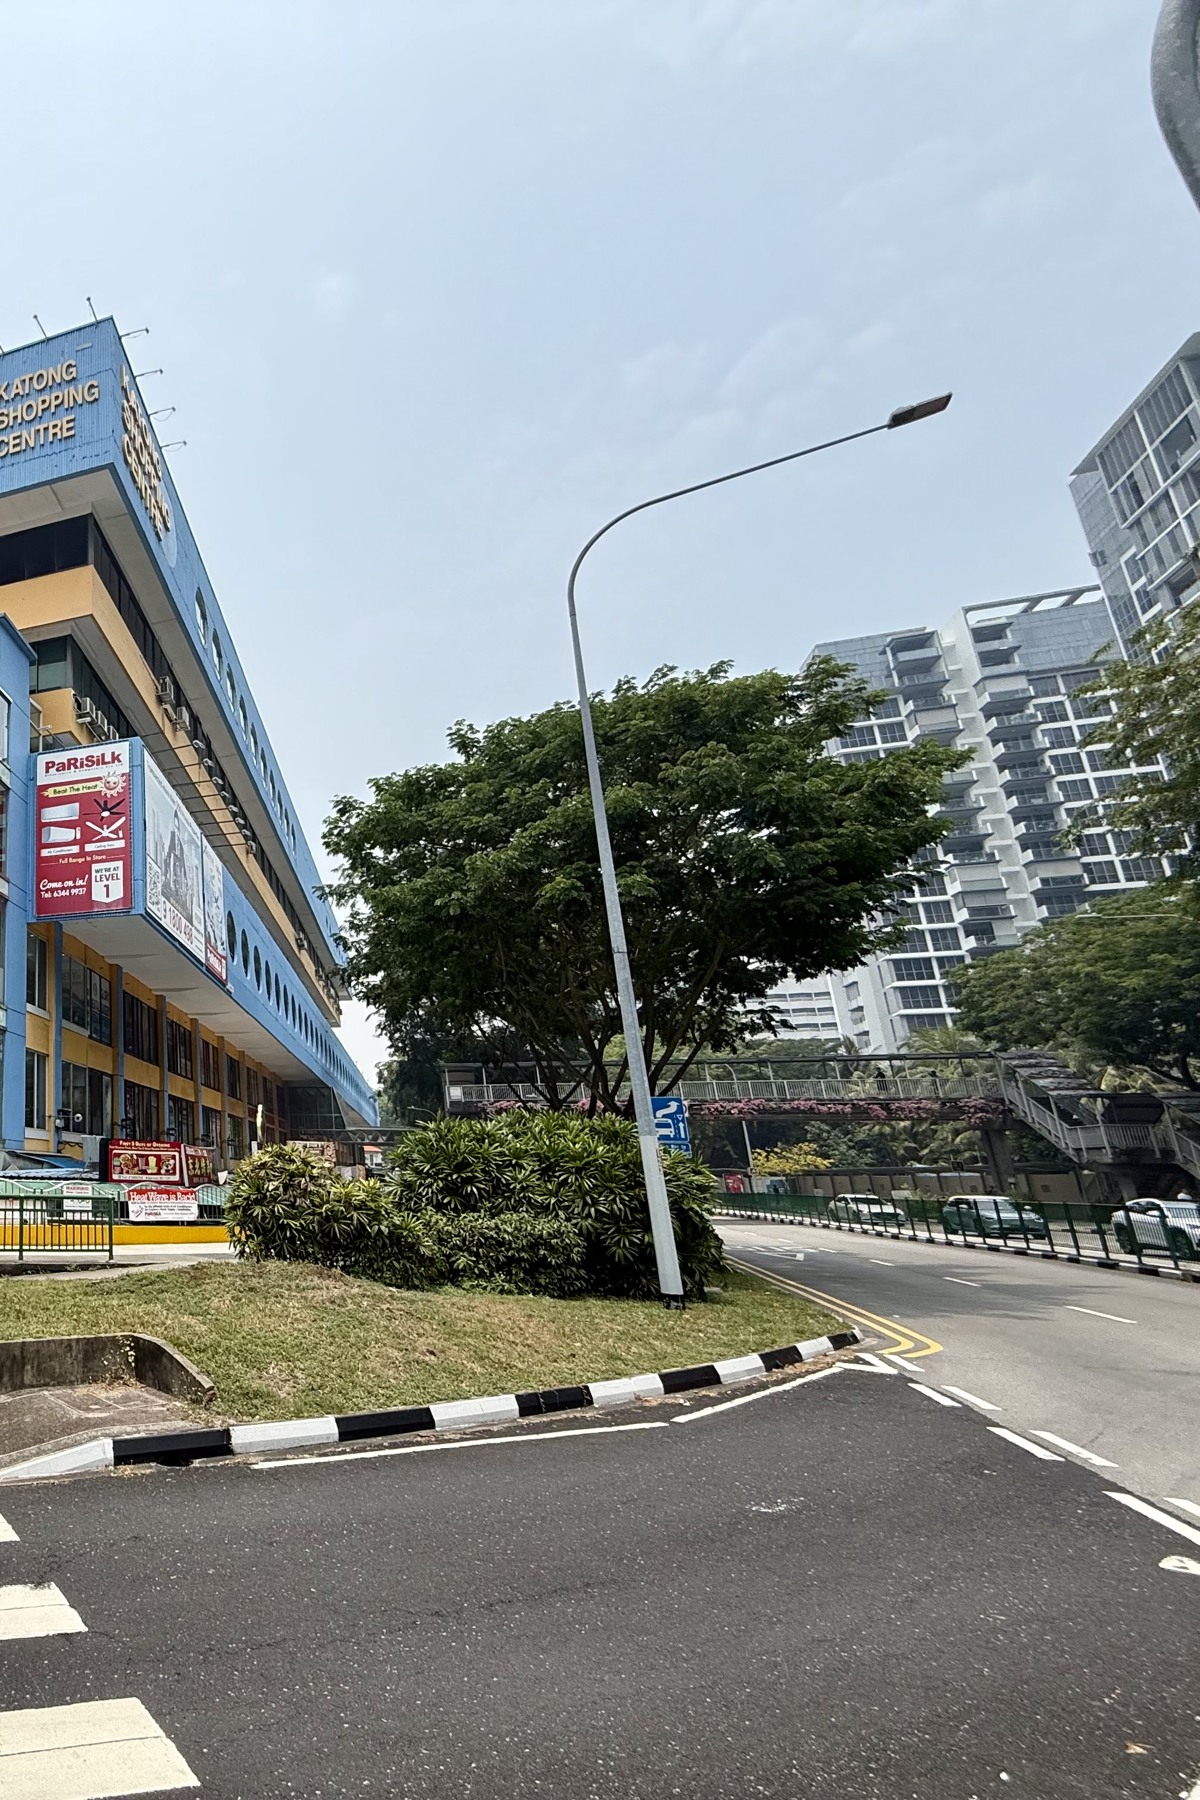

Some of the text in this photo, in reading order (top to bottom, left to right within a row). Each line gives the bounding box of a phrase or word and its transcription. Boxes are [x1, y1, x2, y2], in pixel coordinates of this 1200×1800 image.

[40, 879, 63, 890] Come
[75, 874, 88, 886] in!
[95, 873, 120, 883] LEVEL
[53, 890, 70, 898] 6344
[104, 884, 110, 898] 1
[130, 1192, 196, 1202] Heat Wave is Back!
